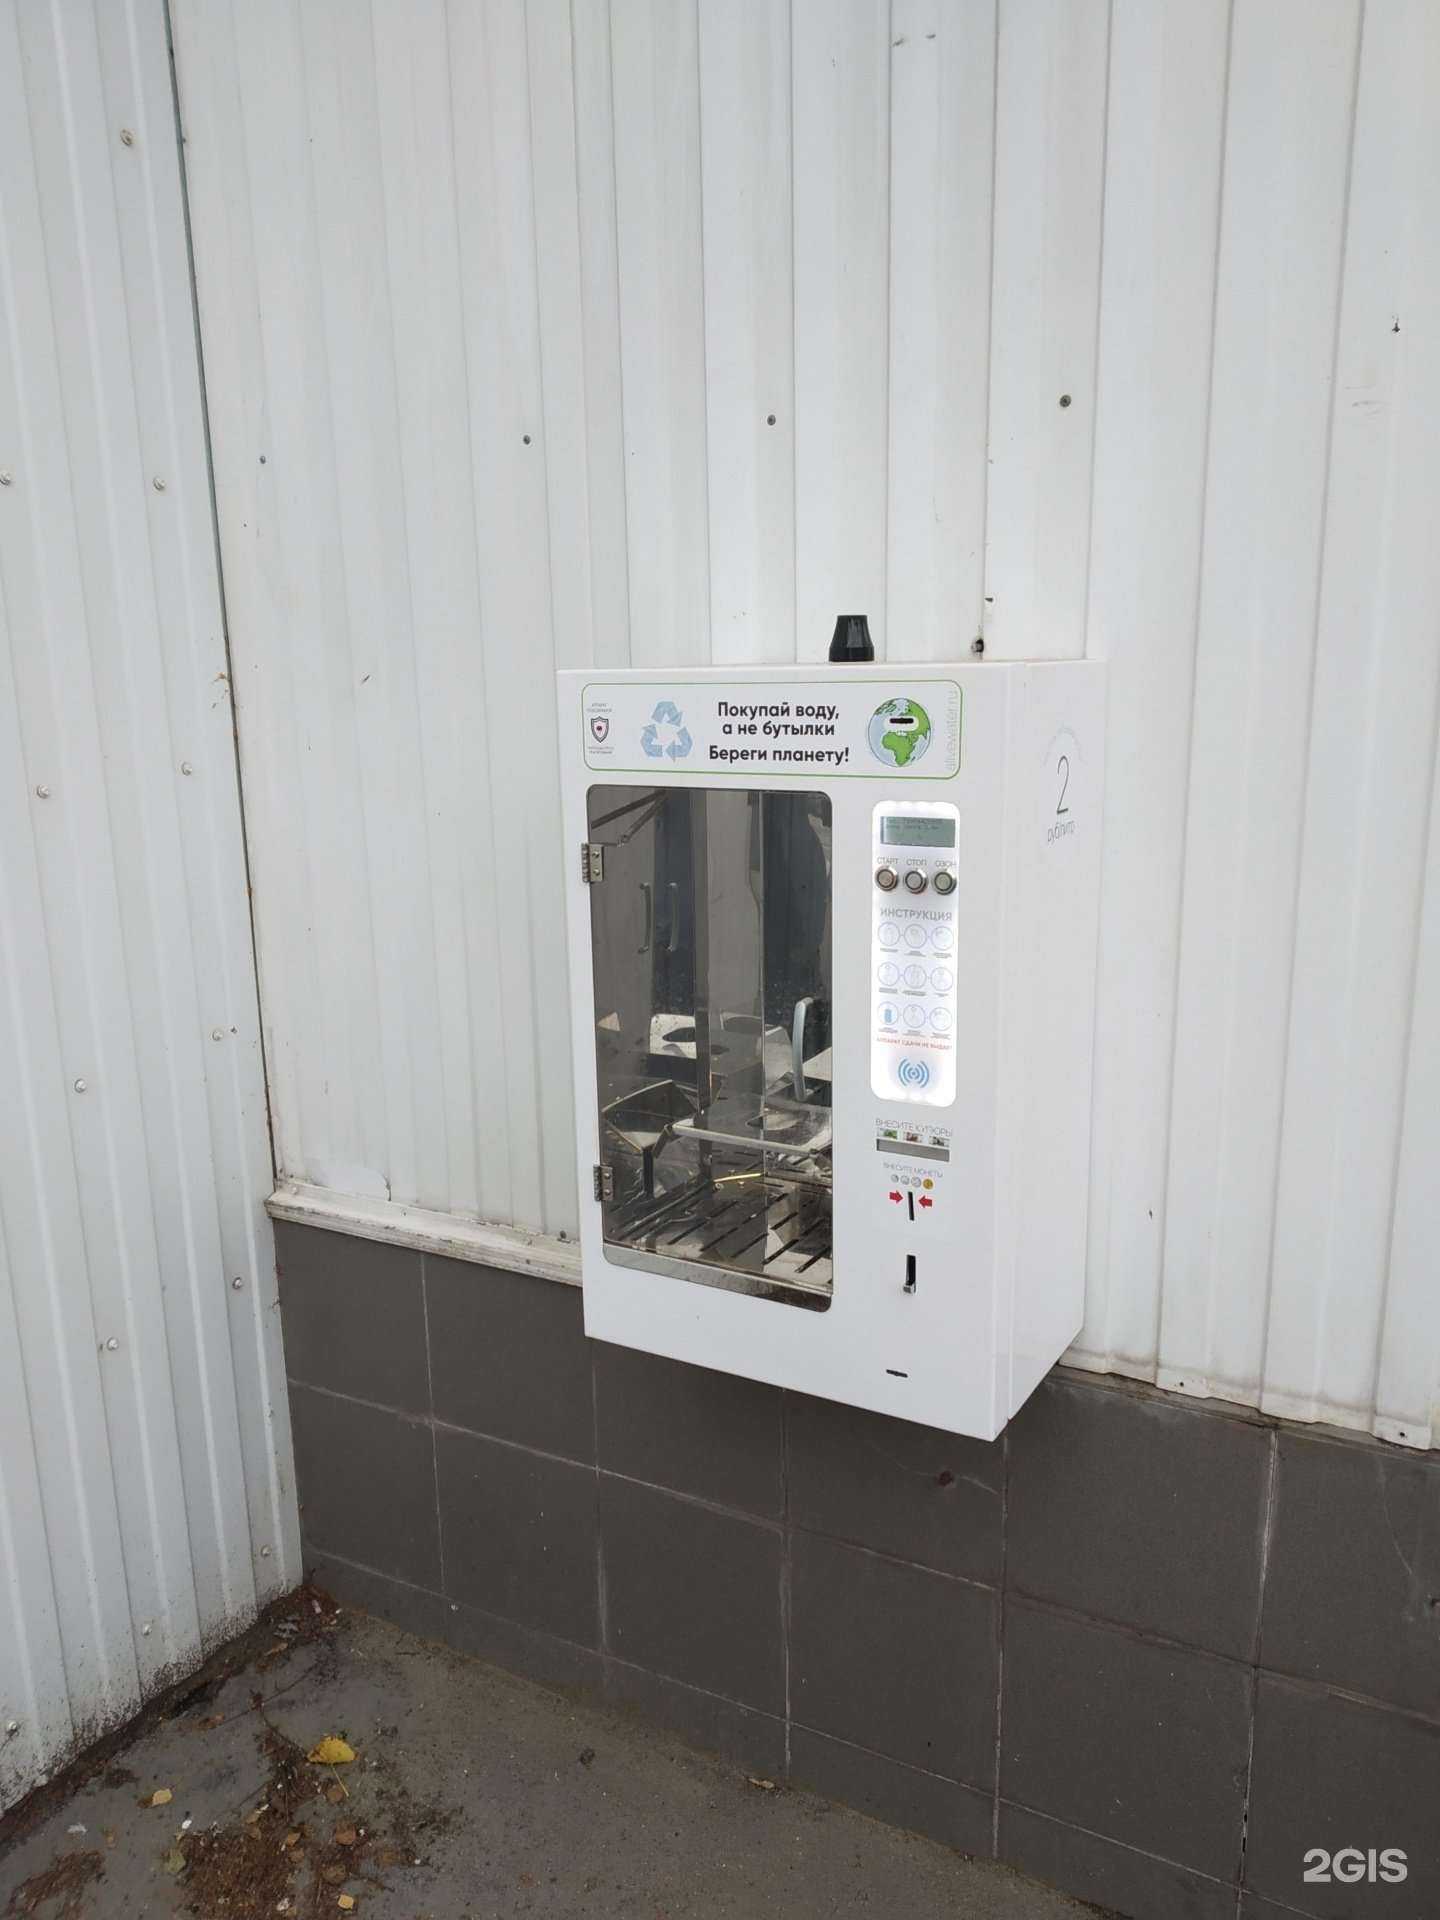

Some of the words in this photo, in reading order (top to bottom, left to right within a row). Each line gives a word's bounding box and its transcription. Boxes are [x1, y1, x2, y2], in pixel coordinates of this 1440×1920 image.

[718, 701, 790, 721] Покупай
[796, 704, 840, 721] воду,
[722, 724, 732, 735] а
[738, 724, 758, 735] не
[762, 721, 835, 739] бутылки
[709, 745, 768, 764] Береги
[773, 747, 849, 766] планету!
[1056, 755, 1070, 815] 2
[880, 908, 952, 921] ИНСТРУКЦИЯ
